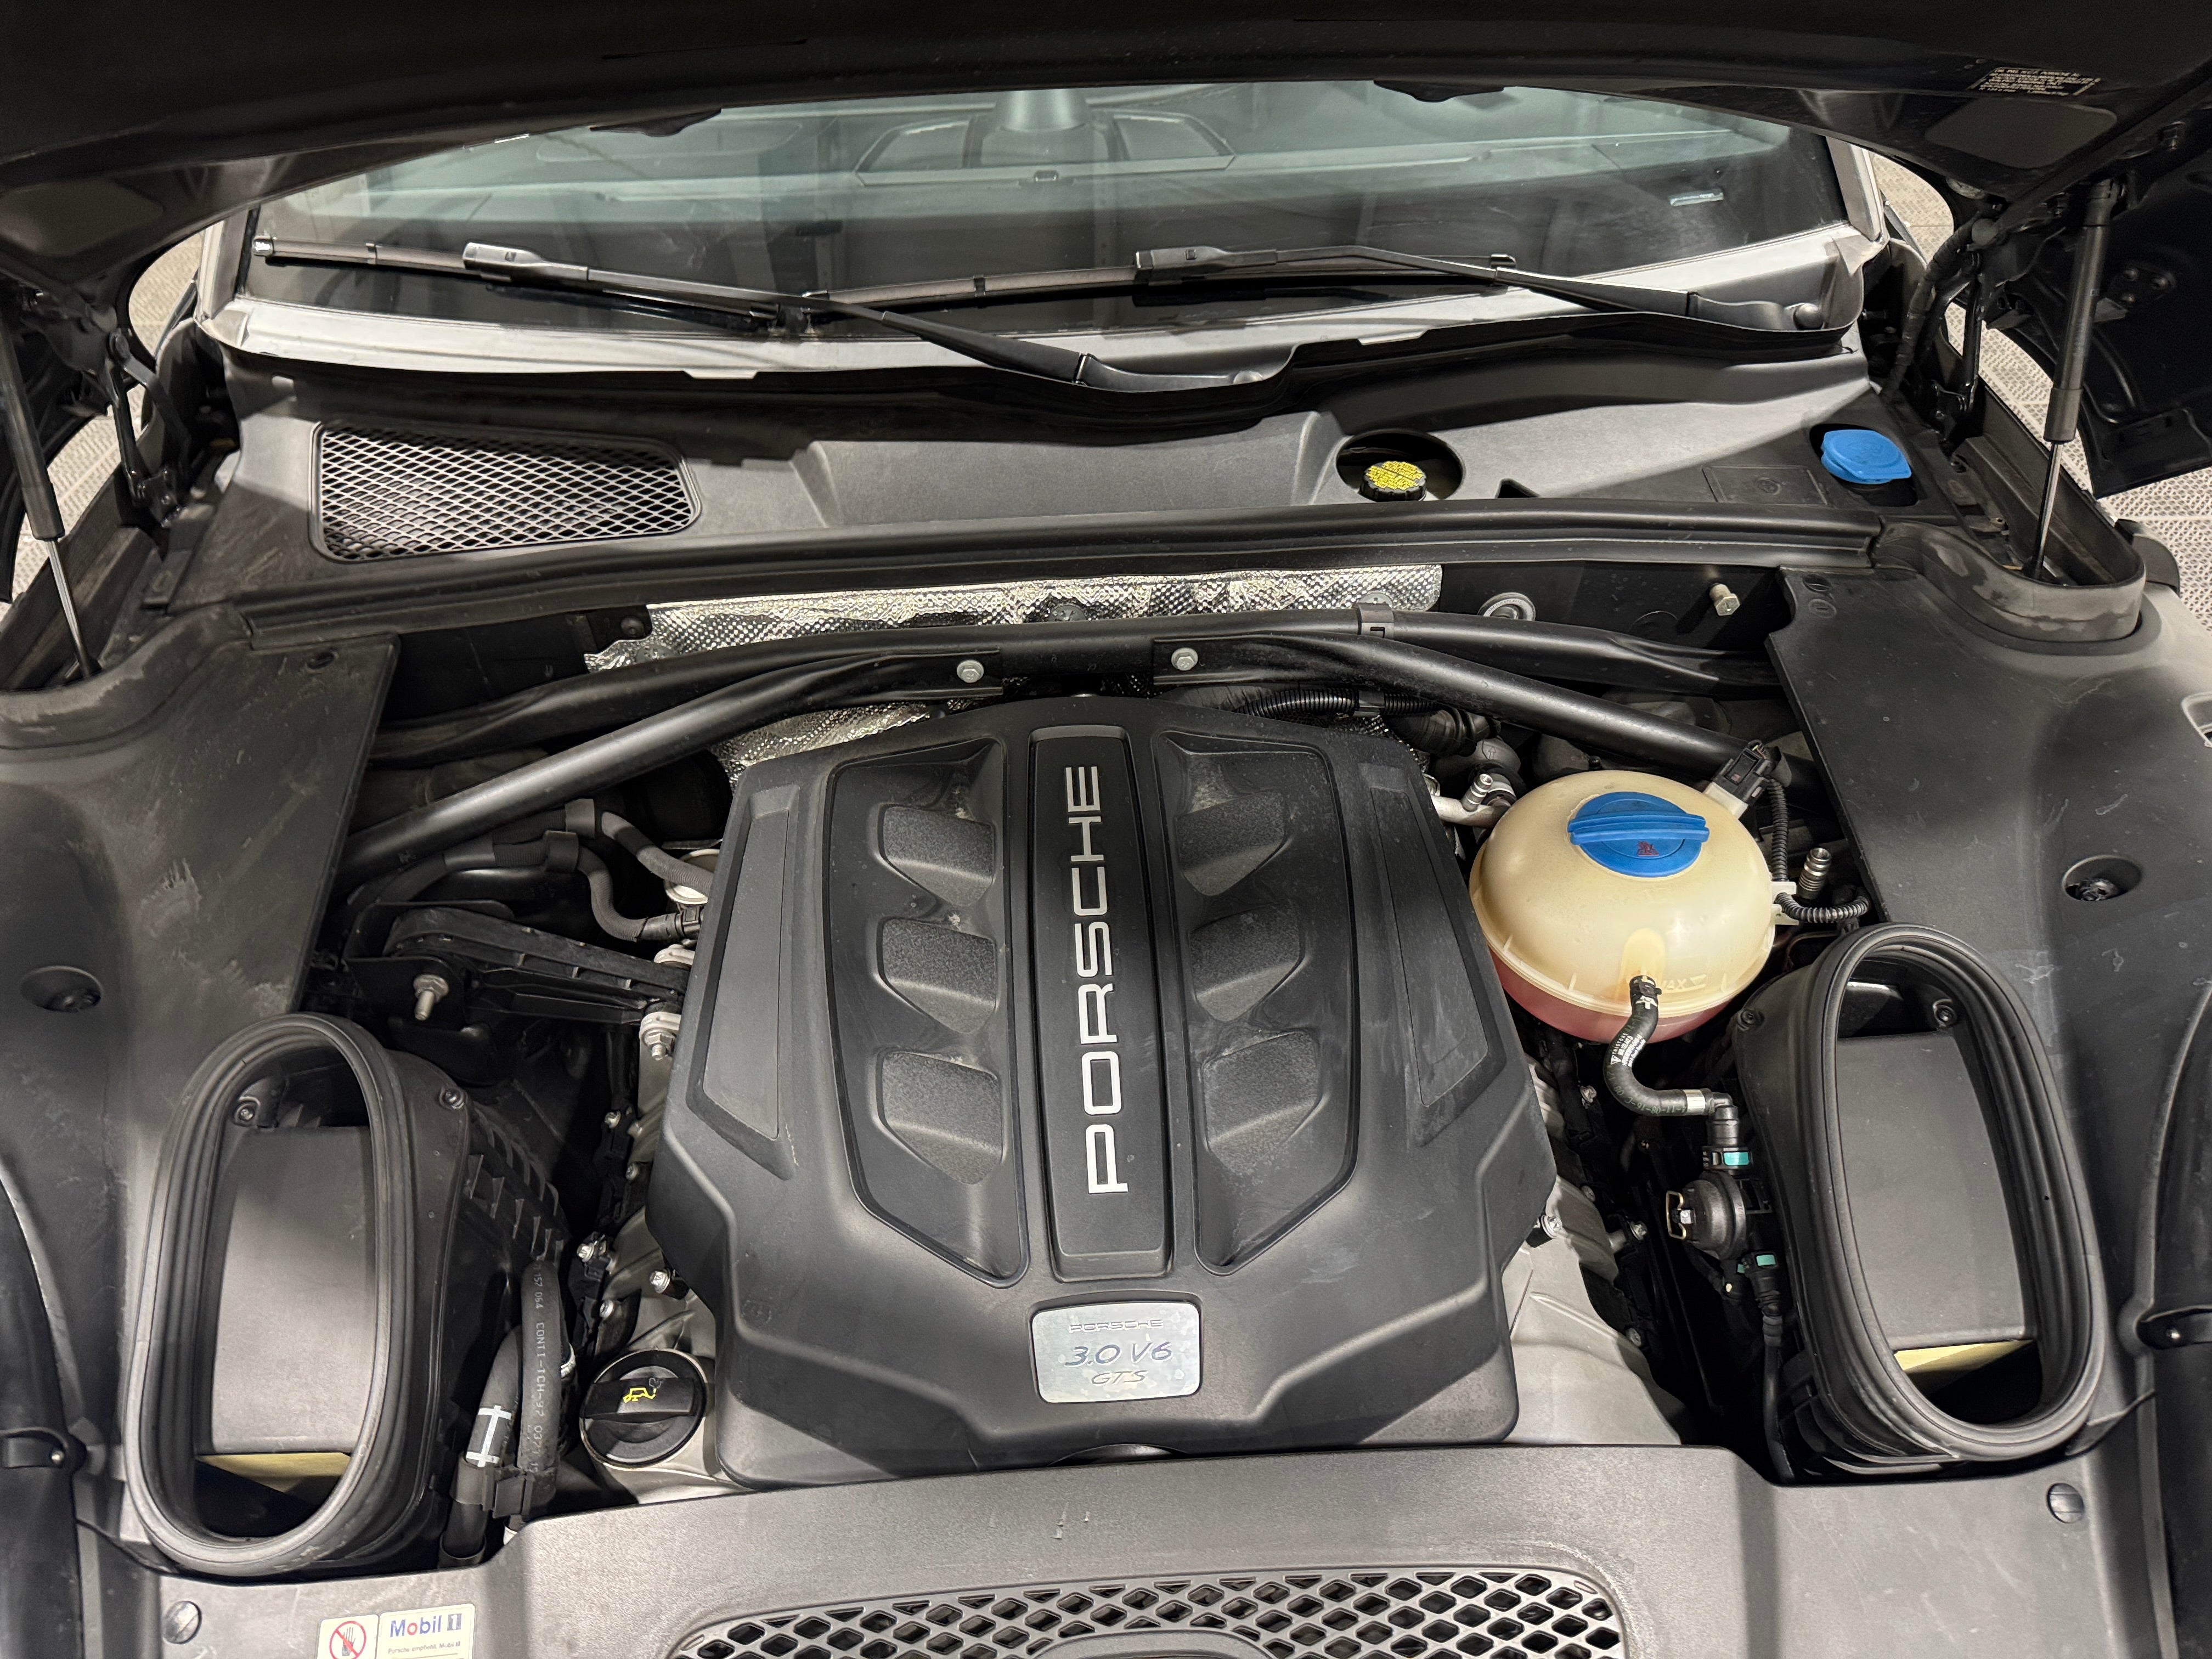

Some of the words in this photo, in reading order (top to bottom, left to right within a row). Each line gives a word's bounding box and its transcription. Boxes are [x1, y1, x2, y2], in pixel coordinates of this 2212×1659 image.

[1065, 766, 1129, 1195] PORSCHE
[1069, 1319, 1164, 1334] PORSCHE
[1064, 1344, 1121, 1368] 3.0
[1131, 1341, 1172, 1364] V6
[1091, 1370, 1148, 1386] GTS
[390, 1615, 442, 1638] Mobil
[447, 1613, 462, 1631] 1
